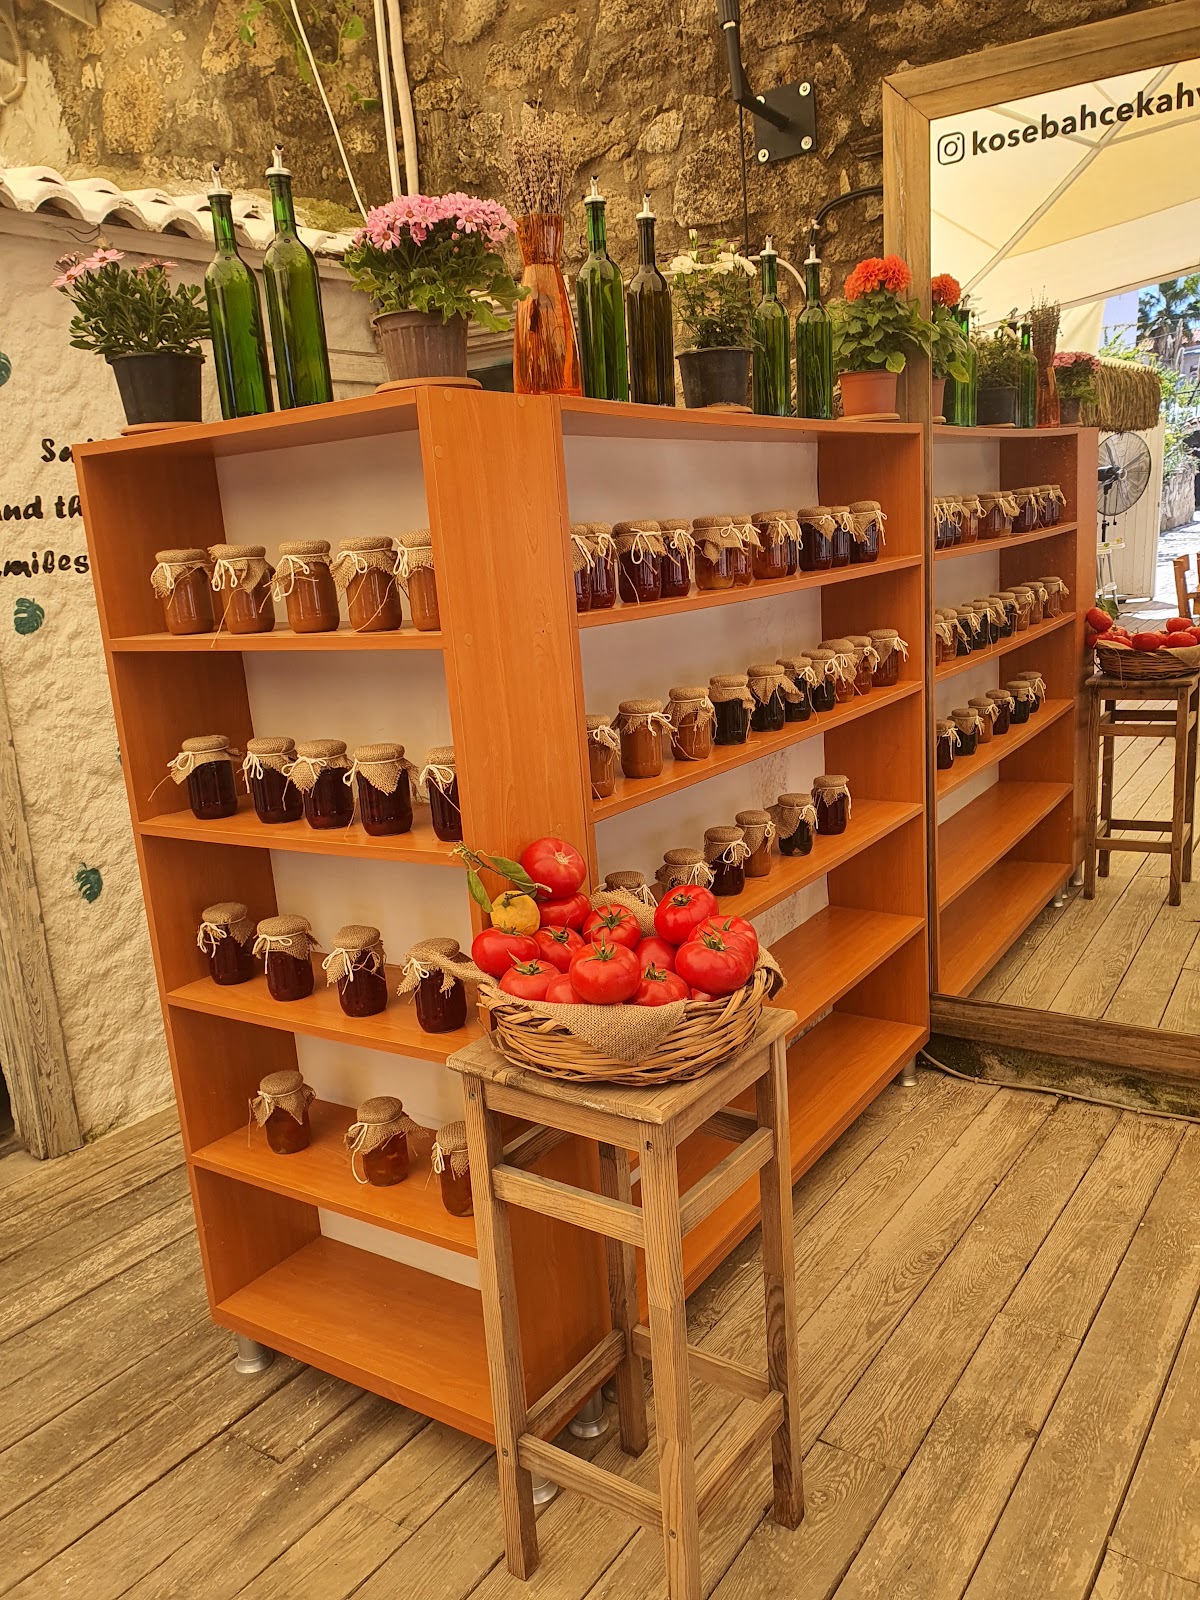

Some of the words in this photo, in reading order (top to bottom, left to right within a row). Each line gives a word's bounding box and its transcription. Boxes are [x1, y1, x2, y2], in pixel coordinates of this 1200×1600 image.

[972, 81, 1200, 156] kosebahcekah
[0, 495, 44, 521] nd
[54, 495, 83, 519] th
[0, 550, 90, 578] miles
